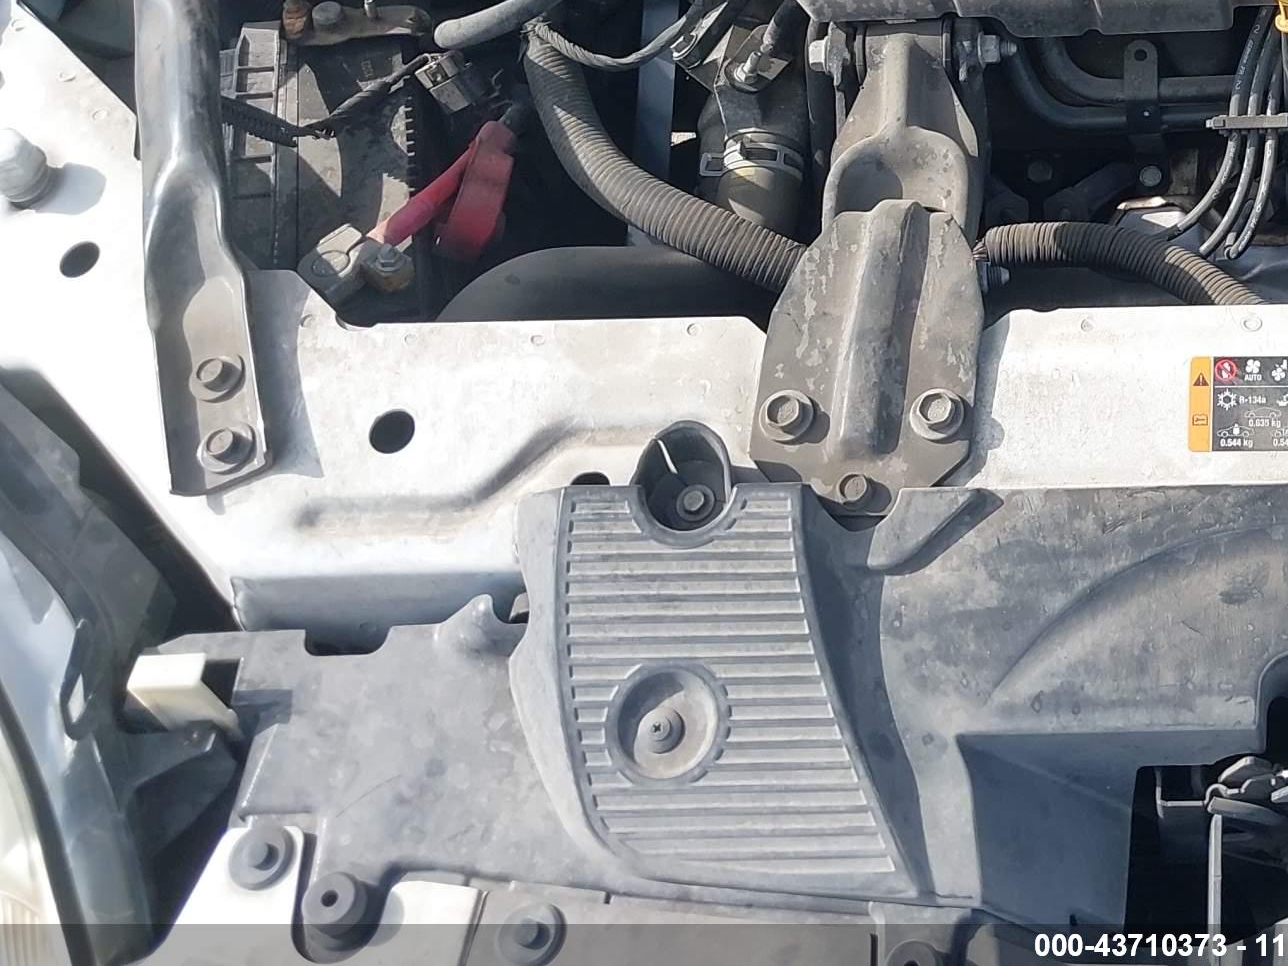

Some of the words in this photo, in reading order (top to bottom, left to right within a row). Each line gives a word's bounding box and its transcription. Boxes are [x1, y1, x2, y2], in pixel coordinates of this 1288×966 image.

[1239, 396, 1267, 404] R-134a
[1271, 418, 1282, 428] kg
[1220, 438, 1242, 447] 0.544
[1243, 438, 1254, 448] kg
